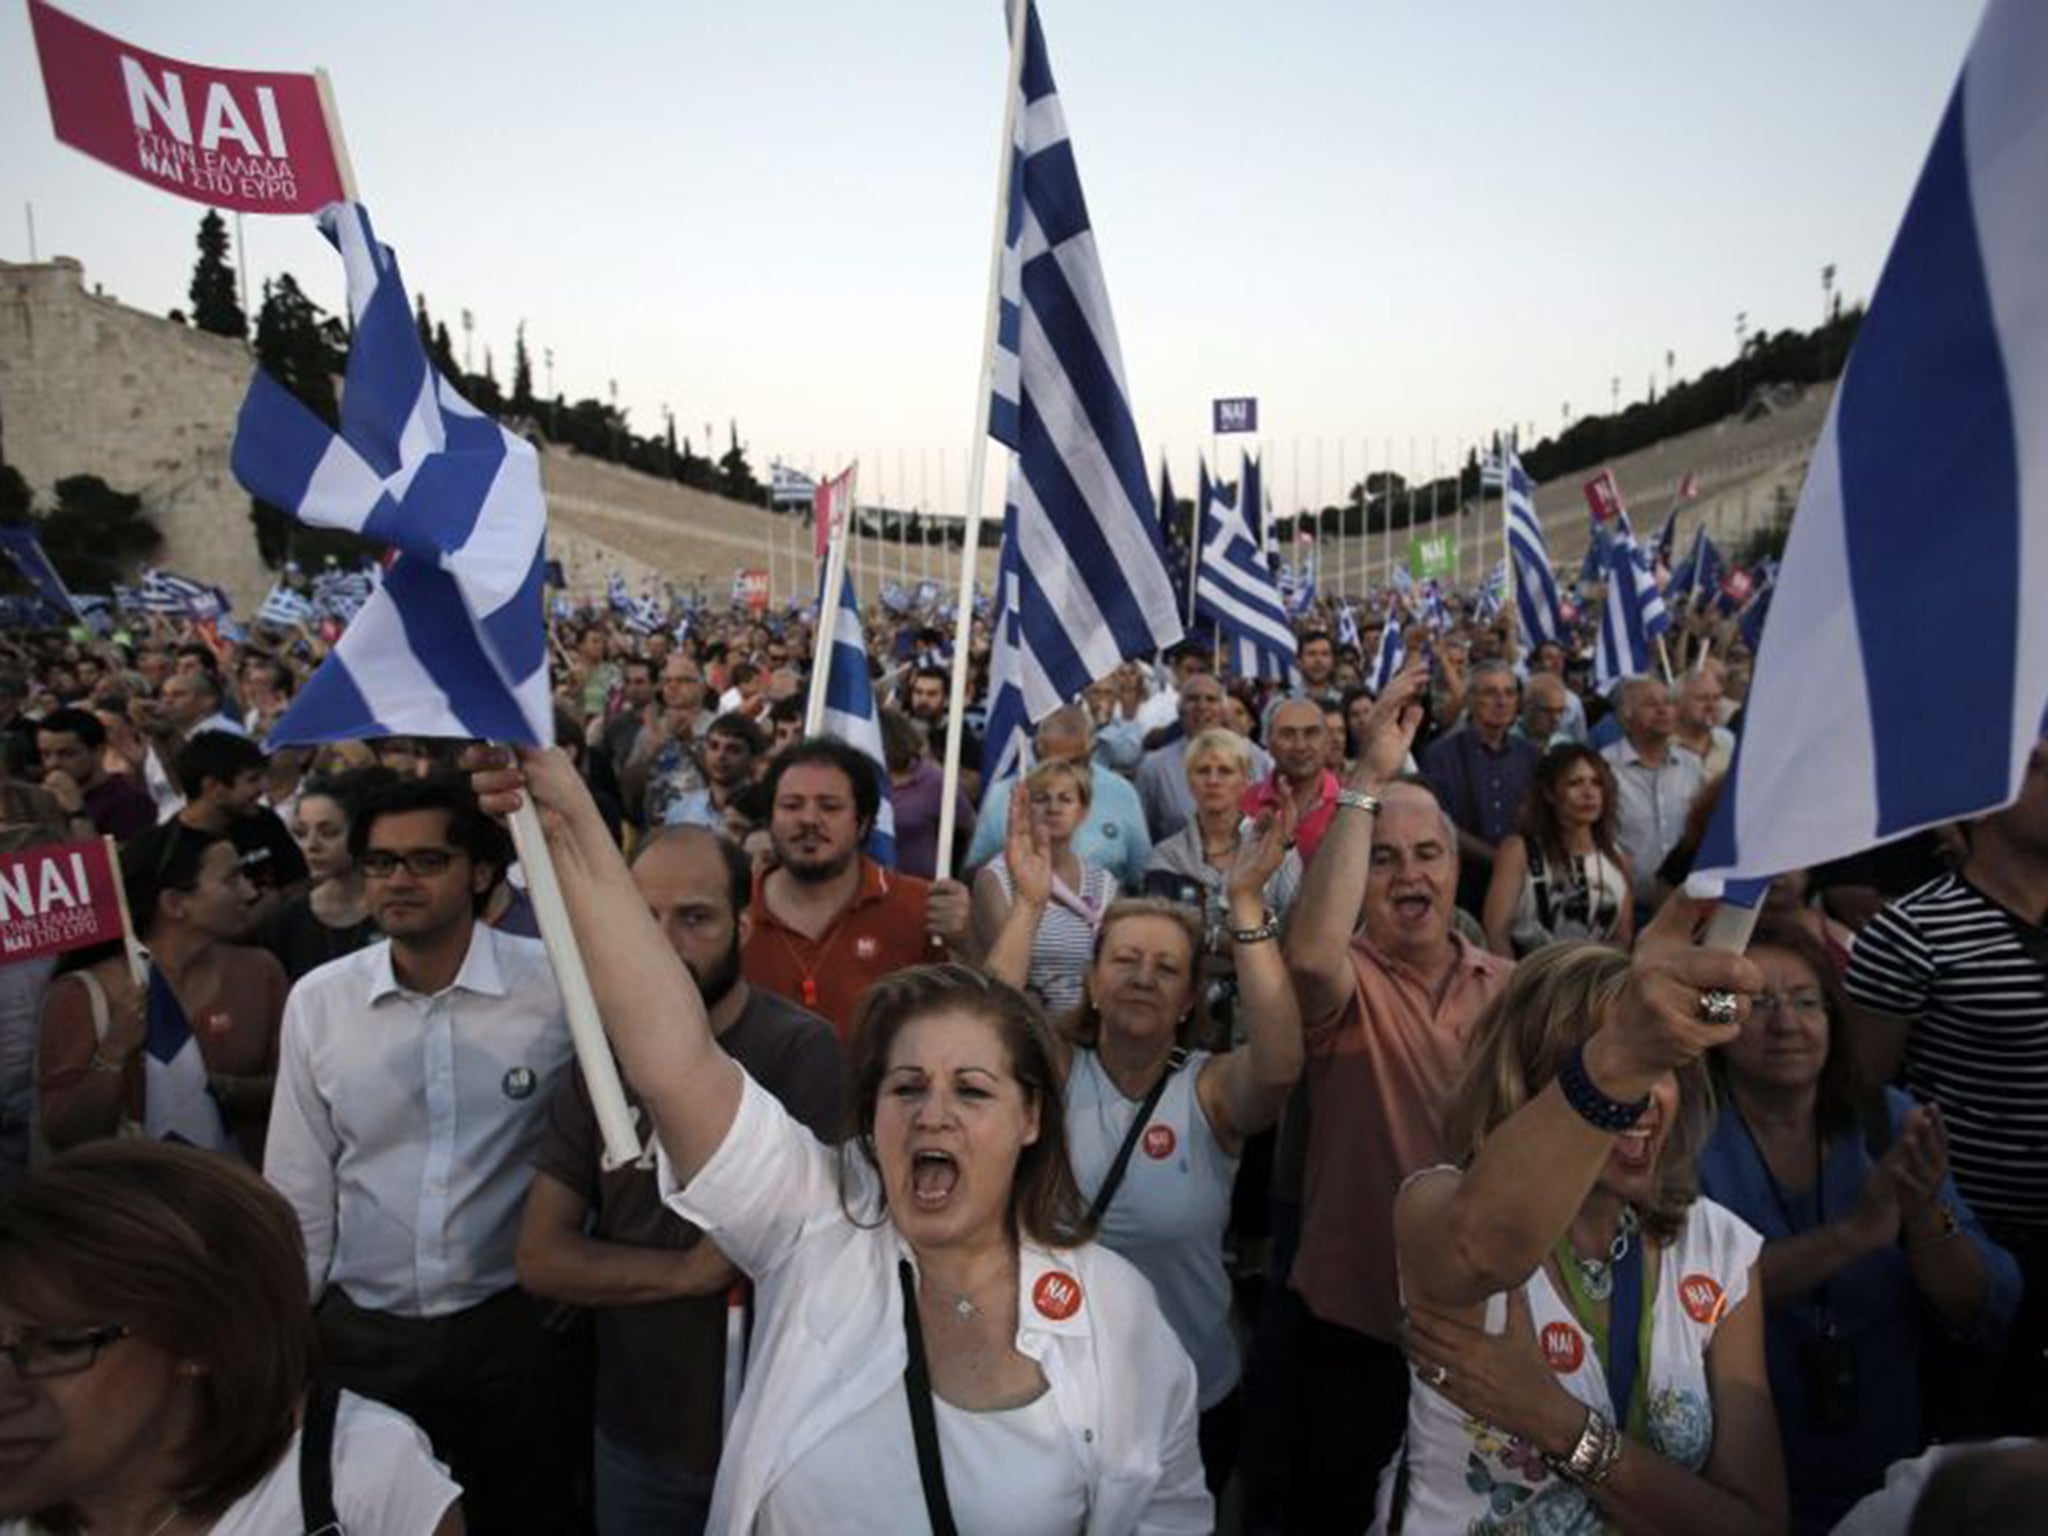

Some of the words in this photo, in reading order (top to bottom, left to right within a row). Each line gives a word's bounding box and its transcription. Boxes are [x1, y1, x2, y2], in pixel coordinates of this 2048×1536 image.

[120, 54, 289, 159] ΝΑΙ
[140, 146, 185, 183] ΝΑΙ
[191, 168, 234, 196] ΣΤΟ
[0, 852, 92, 921] ΝΑΙ
[1043, 1276, 1076, 1306] ΝΑΙ
[1684, 1282, 1716, 1305] ΝΑΙ
[1548, 1331, 1574, 1354] ΝΑΙ
